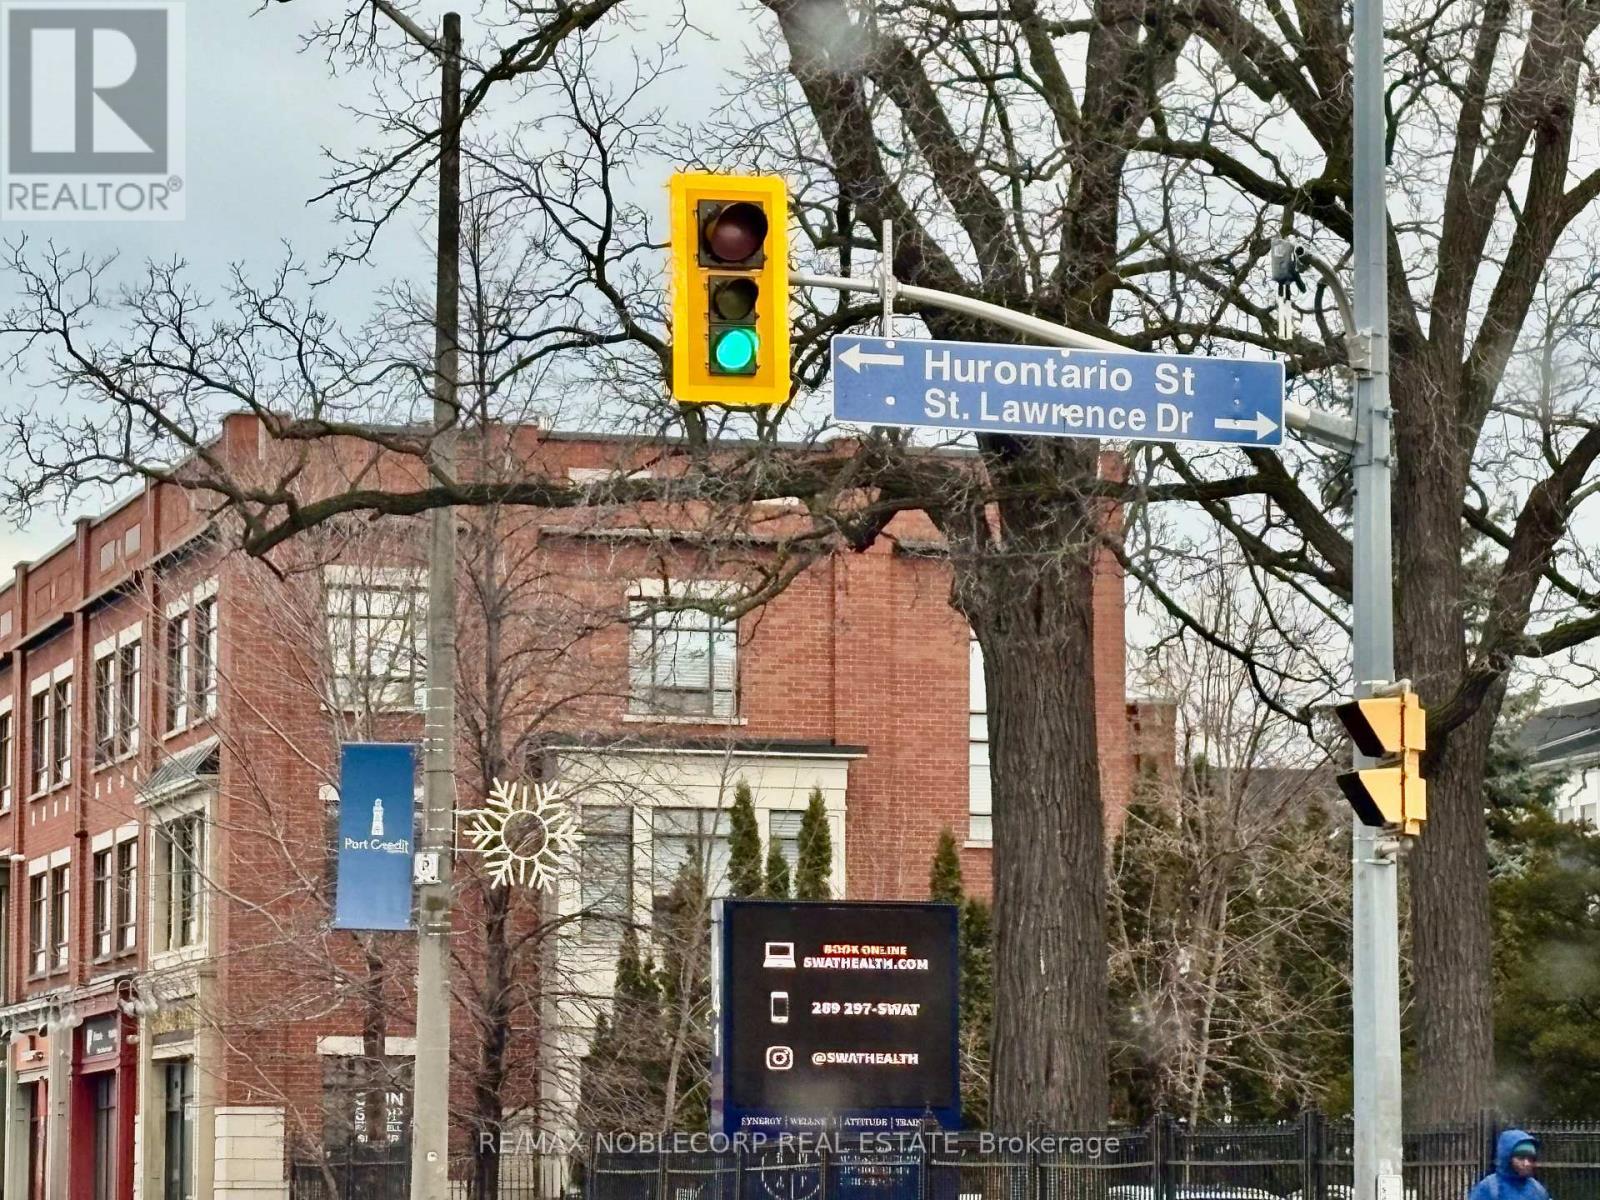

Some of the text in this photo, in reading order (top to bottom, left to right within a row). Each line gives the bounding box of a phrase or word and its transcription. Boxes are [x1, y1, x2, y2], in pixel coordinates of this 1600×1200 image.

[924, 350, 1195, 396] Hurontario St
[924, 387, 1193, 433] St. Lawrence Dr
[344, 837, 369, 850] Port
[824, 944, 907, 956] BOOK ONLINE
[803, 957, 929, 970] SWATHEALTH.COM
[844, 1002, 920, 1016] 297-SWAT
[812, 1052, 919, 1065] @SWATHEALTH
[741, 1117, 782, 1126] SYNERGY
[844, 1117, 888, 1127] ATTITUDE
